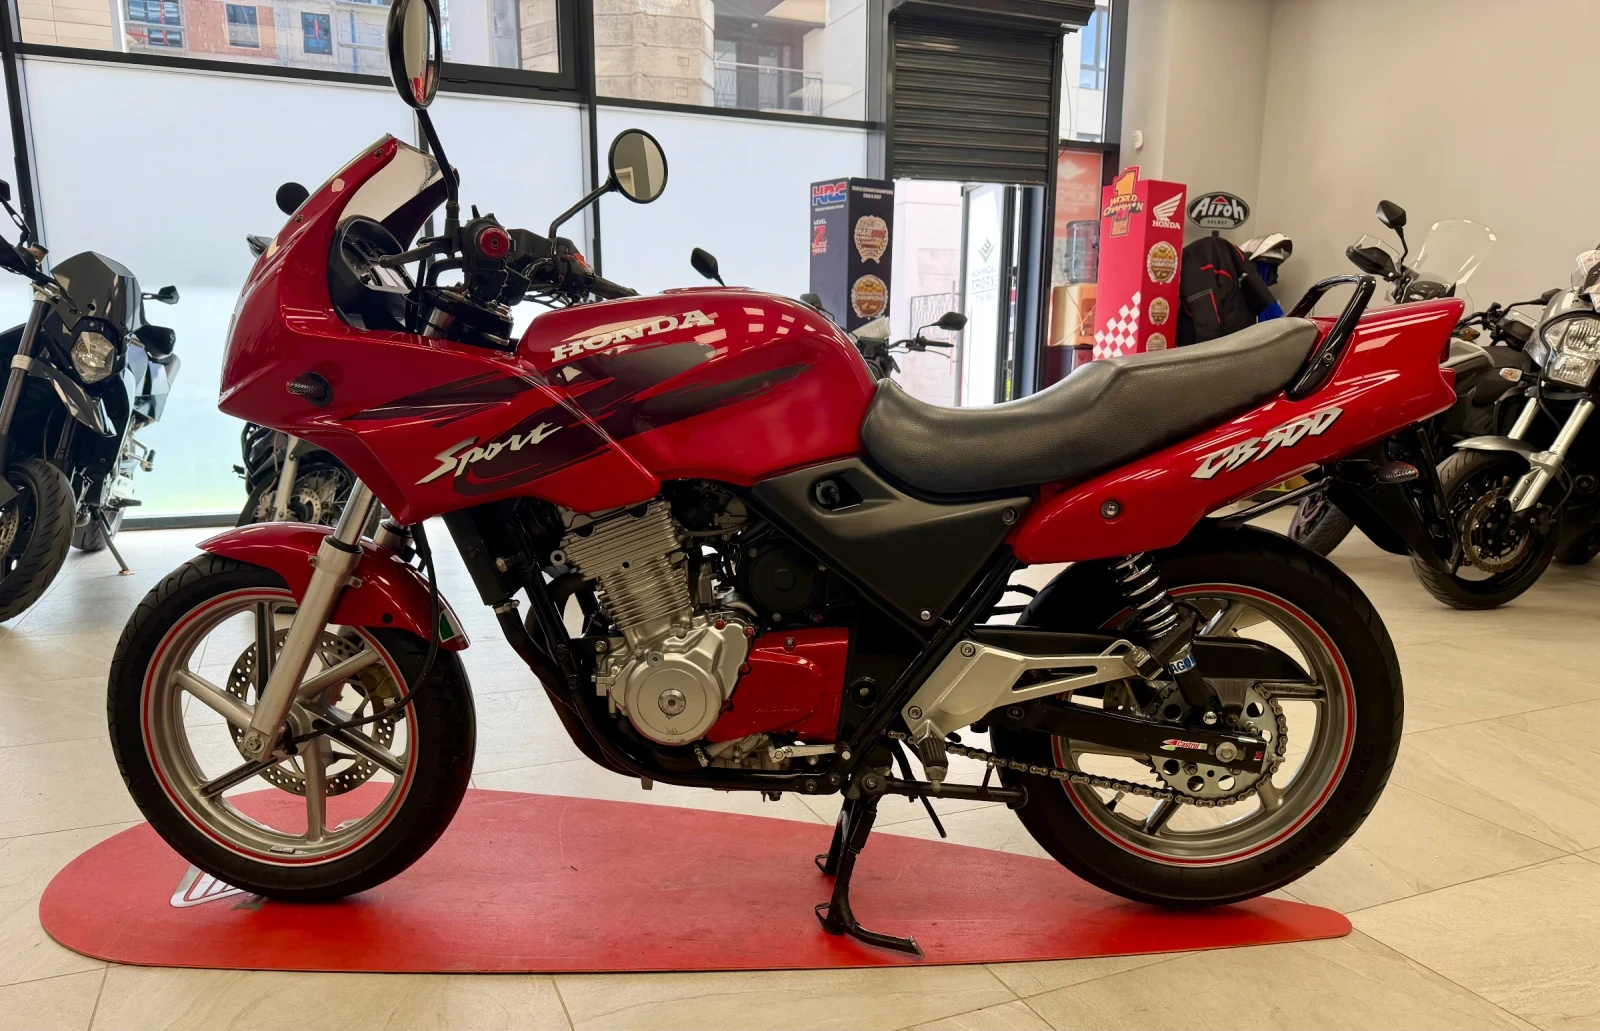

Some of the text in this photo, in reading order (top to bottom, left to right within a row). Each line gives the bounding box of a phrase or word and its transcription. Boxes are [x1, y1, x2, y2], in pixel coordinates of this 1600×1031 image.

[812, 182, 847, 206] HRC
[1110, 194, 1138, 208] WORLD
[1191, 197, 1244, 221] Airoh
[1152, 220, 1181, 230] HONDA
[551, 310, 714, 362] HONDA
[414, 422, 563, 485] Sport
[1177, 740, 1200, 749] Castrol
